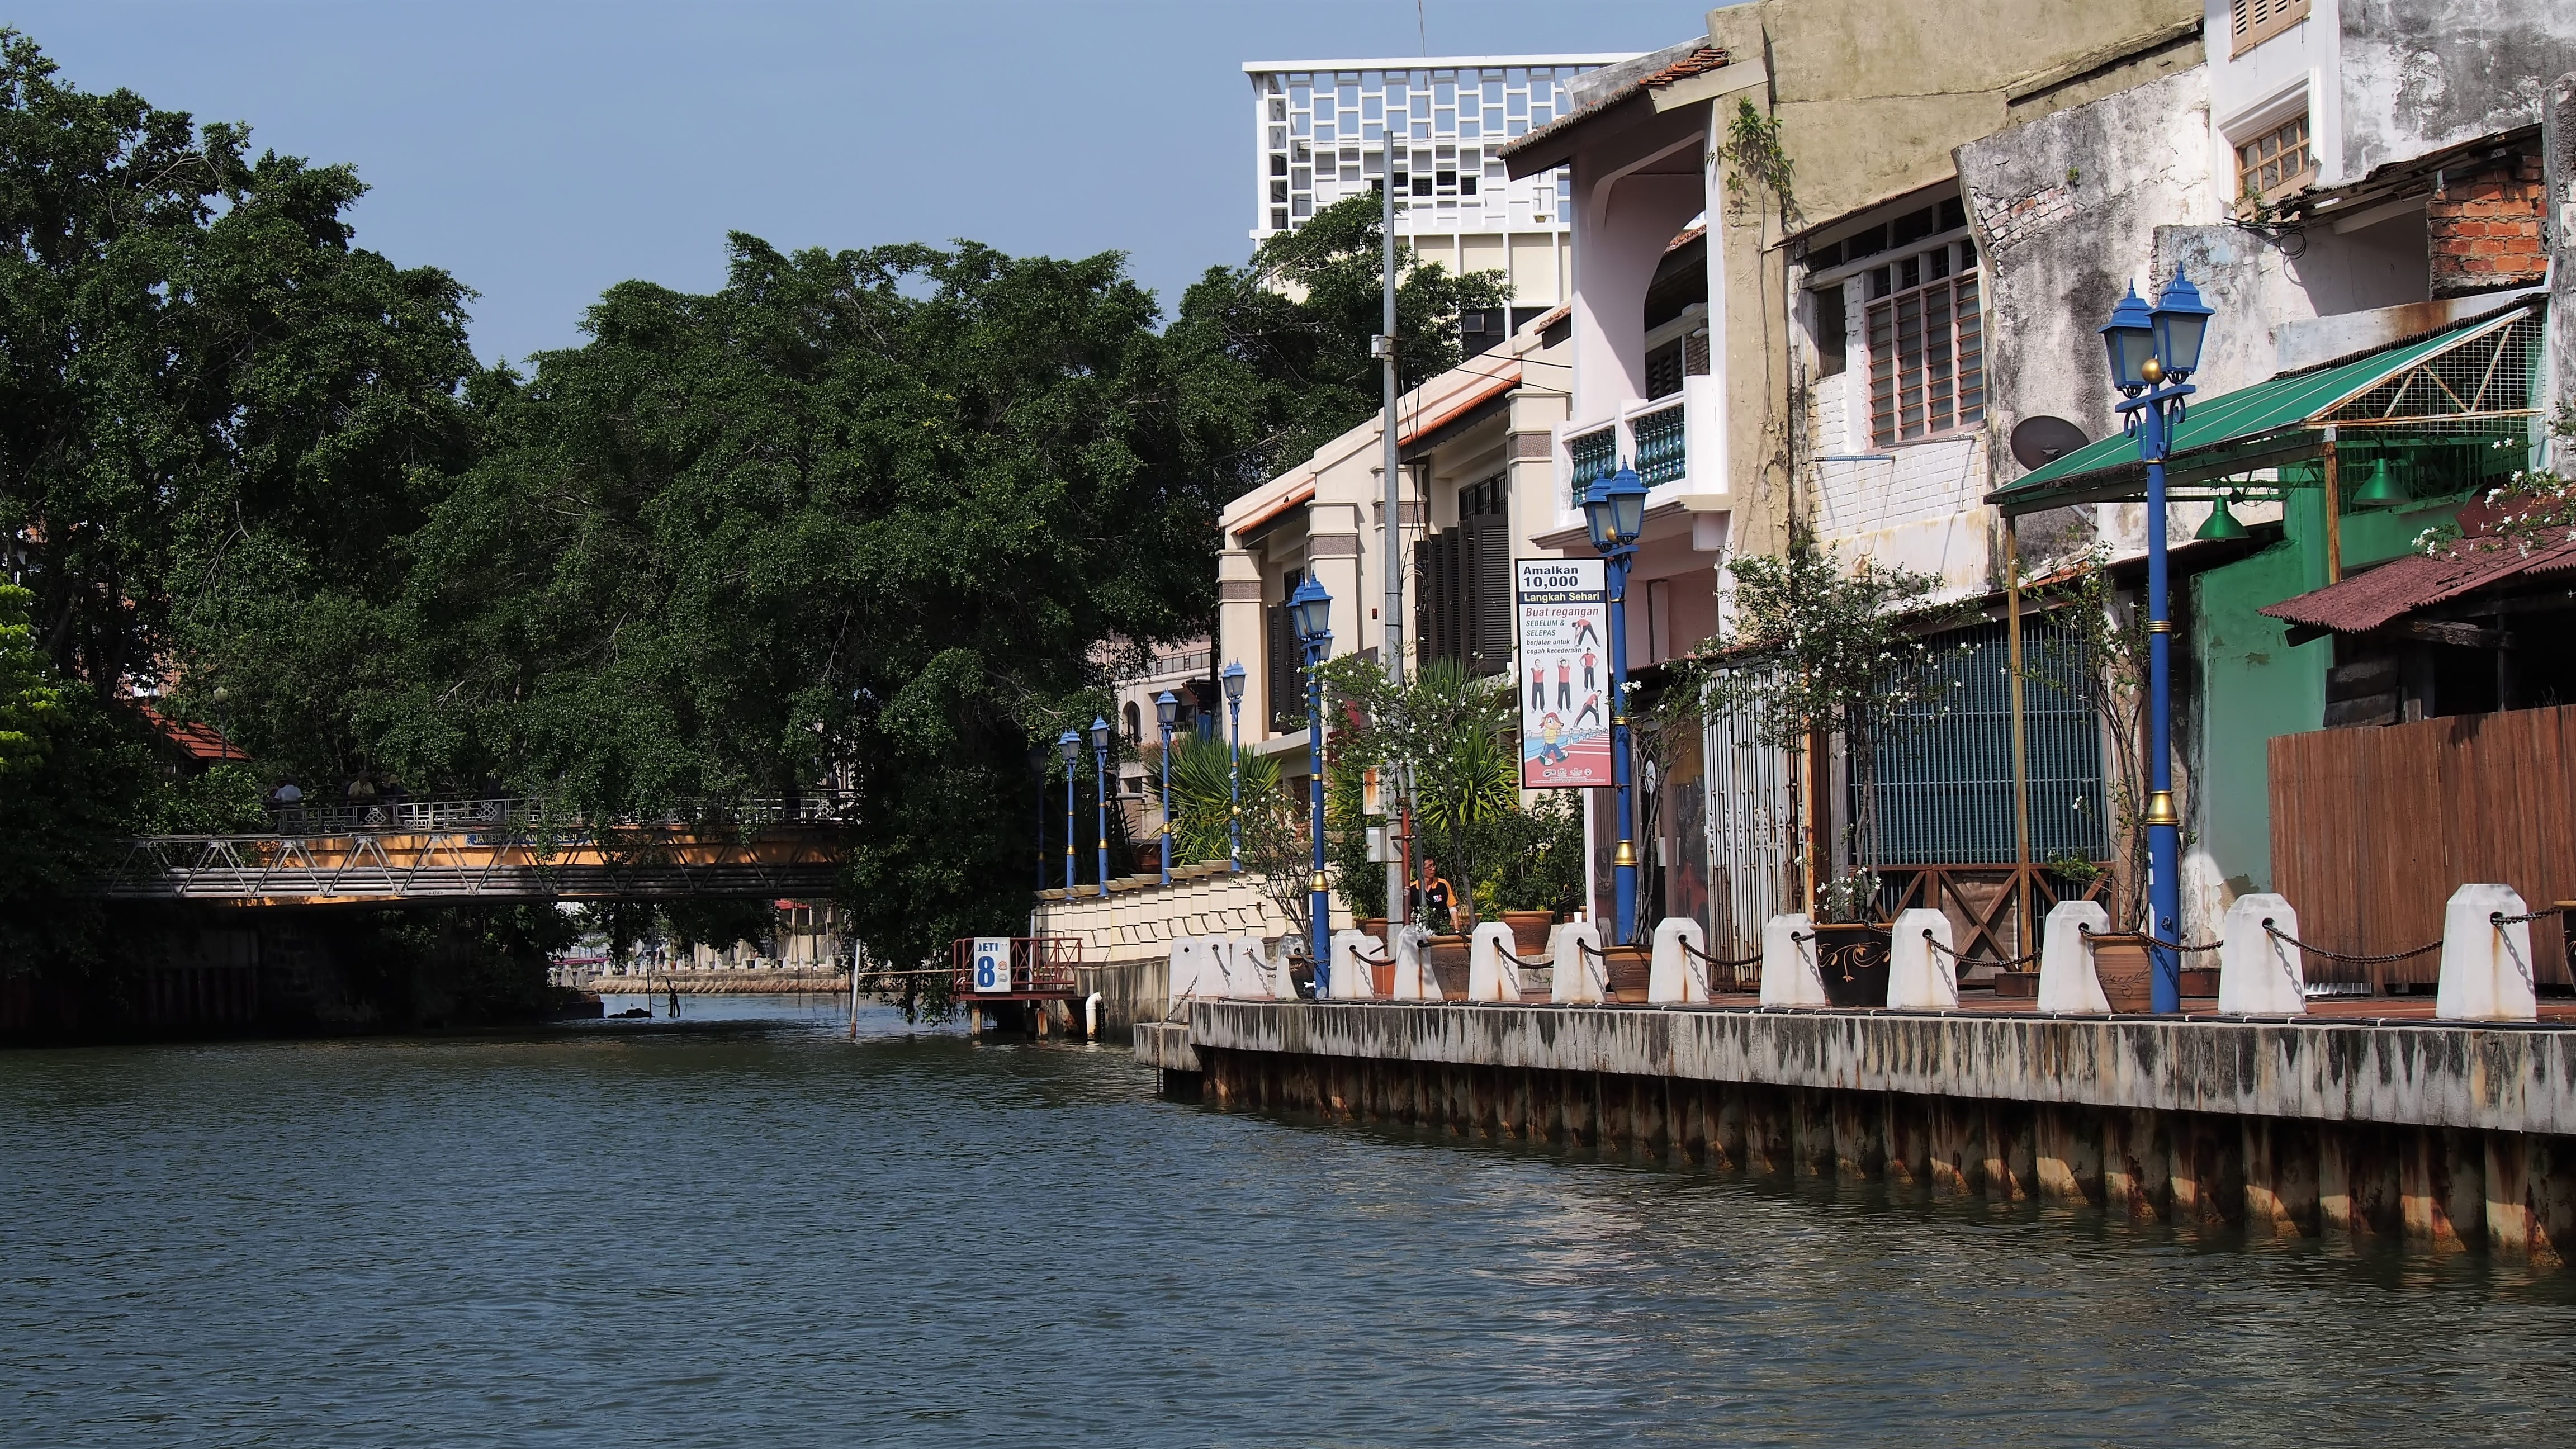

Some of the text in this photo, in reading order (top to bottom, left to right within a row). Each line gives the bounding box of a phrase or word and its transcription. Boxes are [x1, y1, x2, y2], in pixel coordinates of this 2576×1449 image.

[1523, 566, 1579, 575] Amalkan
[1523, 576, 1579, 589] 10,000
[1524, 591, 1600, 603] Langkah Sehari
[1526, 607, 1599, 618] Buat regangan
[977, 943, 998, 951] JETI
[977, 956, 995, 988] 8
